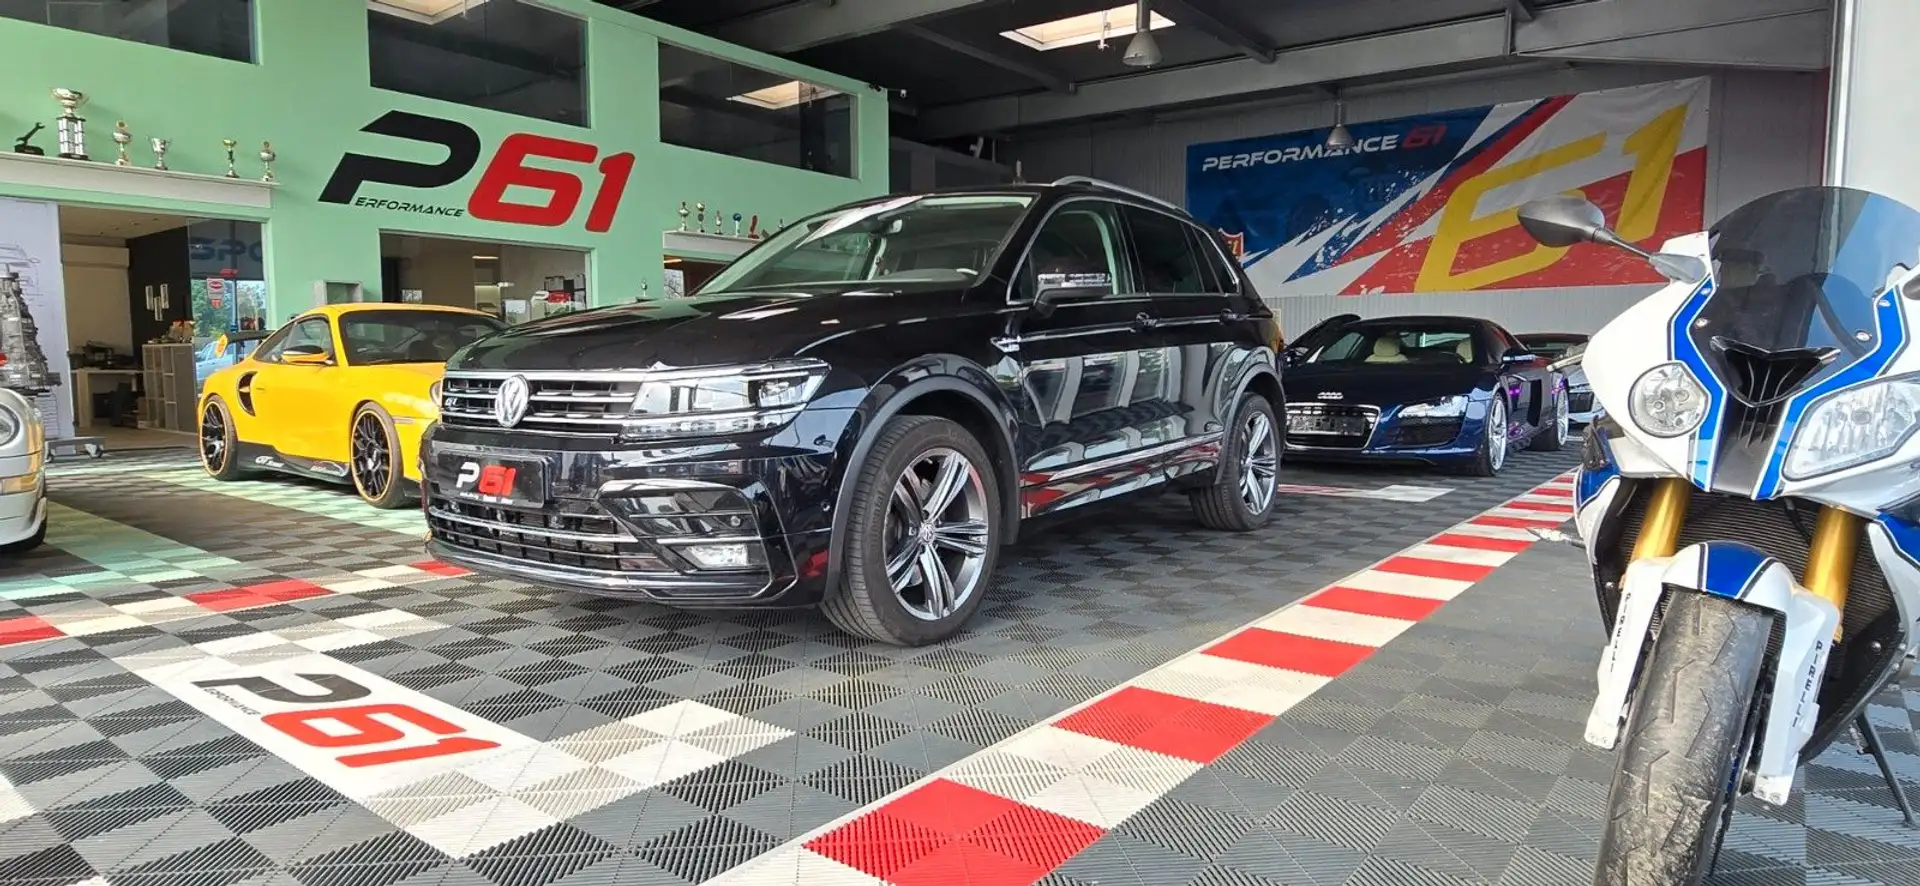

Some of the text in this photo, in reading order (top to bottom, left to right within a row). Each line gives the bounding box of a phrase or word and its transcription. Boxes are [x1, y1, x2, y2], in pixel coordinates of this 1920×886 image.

[1402, 124, 1447, 149] 61
[456, 461, 517, 497] P61
[1609, 592, 1632, 673] PIRELLI
[1792, 640, 1824, 728] PIRELLI
